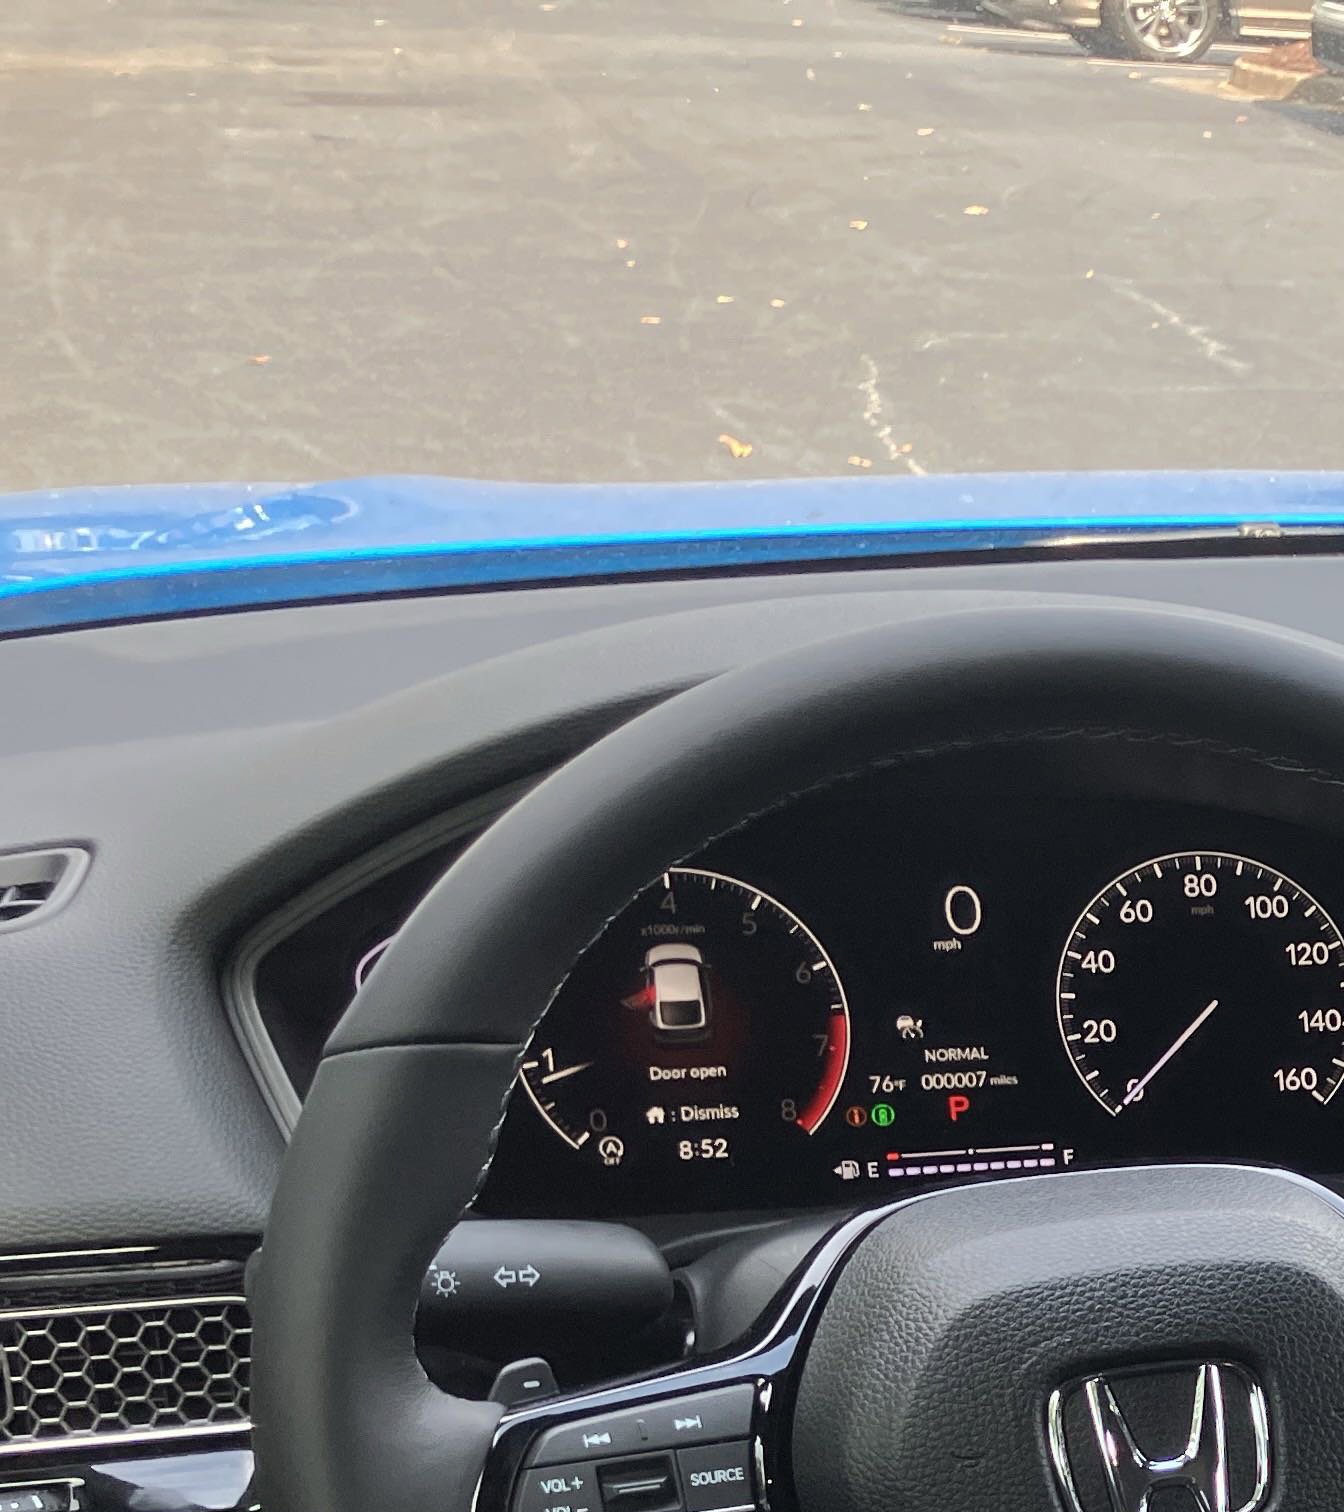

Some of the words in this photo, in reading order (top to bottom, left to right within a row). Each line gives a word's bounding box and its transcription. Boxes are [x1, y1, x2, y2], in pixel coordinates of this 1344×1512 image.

[1183, 874, 1217, 898] 80
[659, 891, 676, 914] 4
[945, 885, 982, 935] 0
[1119, 899, 1153, 924] 60
[1191, 905, 1215, 916] mph
[1244, 895, 1289, 920] 100
[742, 912, 757, 935] 5
[933, 938, 962, 953] mph
[1285, 941, 1330, 966] 120
[795, 962, 812, 983] 6
[1081, 950, 1115, 974] 40
[1082, 1019, 1117, 1045] 20
[1298, 1009, 1342, 1033] 140
[812, 1034, 828, 1056] 7
[924, 1046, 989, 1063] NORMAL
[542, 1048, 553, 1071] 1
[649, 1067, 686, 1081] Door
[690, 1065, 727, 1081] open
[921, 1070, 987, 1091] 000007
[990, 1075, 1018, 1086] miles
[1273, 1067, 1318, 1091] 160
[680, 1104, 740, 1122] Dismiss
[781, 1099, 797, 1121] 8
[949, 1095, 970, 1121] P
[590, 1110, 607, 1131] 0
[679, 1138, 728, 1160] 8:52
[1063, 1149, 1074, 1166] F
[867, 1161, 879, 1178] E
[690, 1467, 745, 1487] SOURCE
